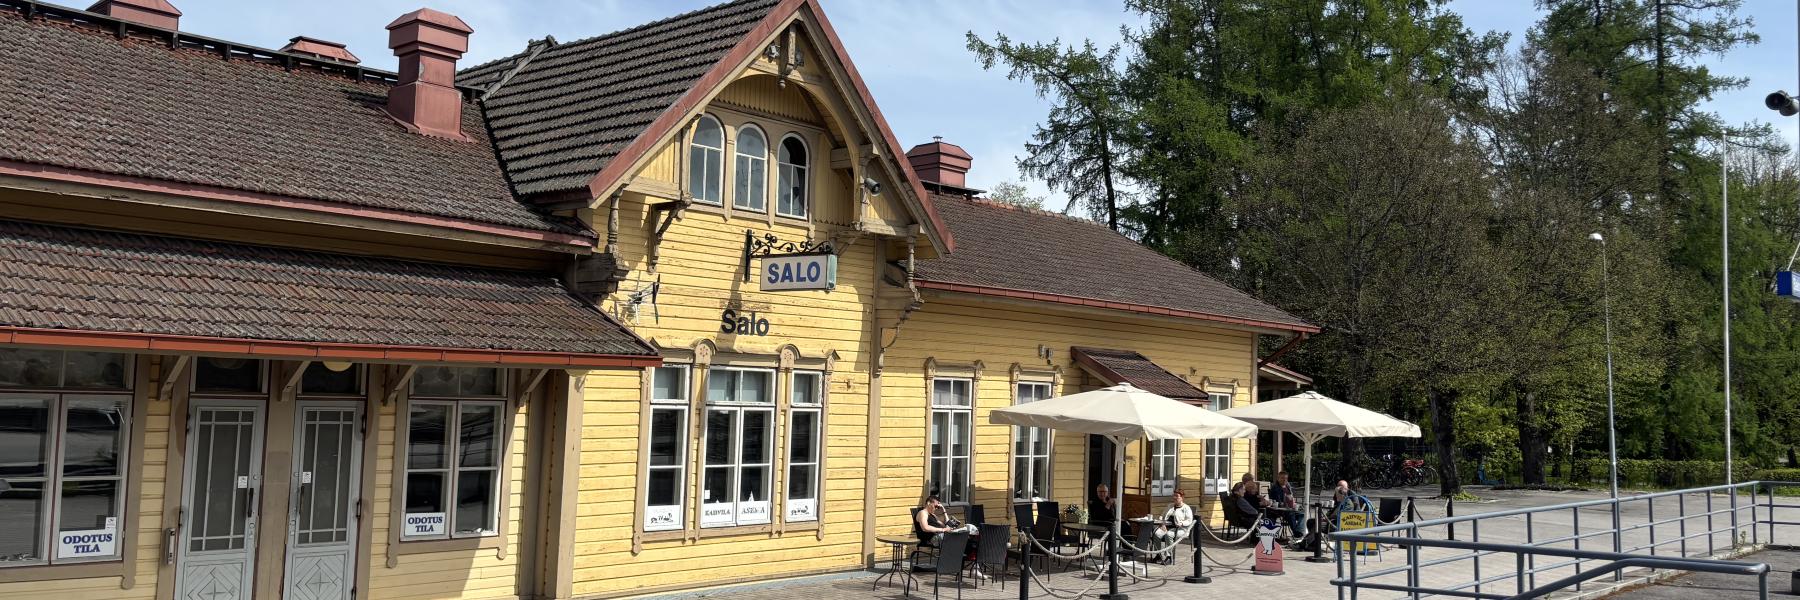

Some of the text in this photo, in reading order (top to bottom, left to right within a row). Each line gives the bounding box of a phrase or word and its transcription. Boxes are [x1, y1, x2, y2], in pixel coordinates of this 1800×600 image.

[768, 261, 821, 283] SALO
[721, 309, 769, 336] Salo
[408, 516, 443, 524] ODOTUS
[63, 533, 113, 544] ODOTUS
[74, 544, 100, 553] TILA
